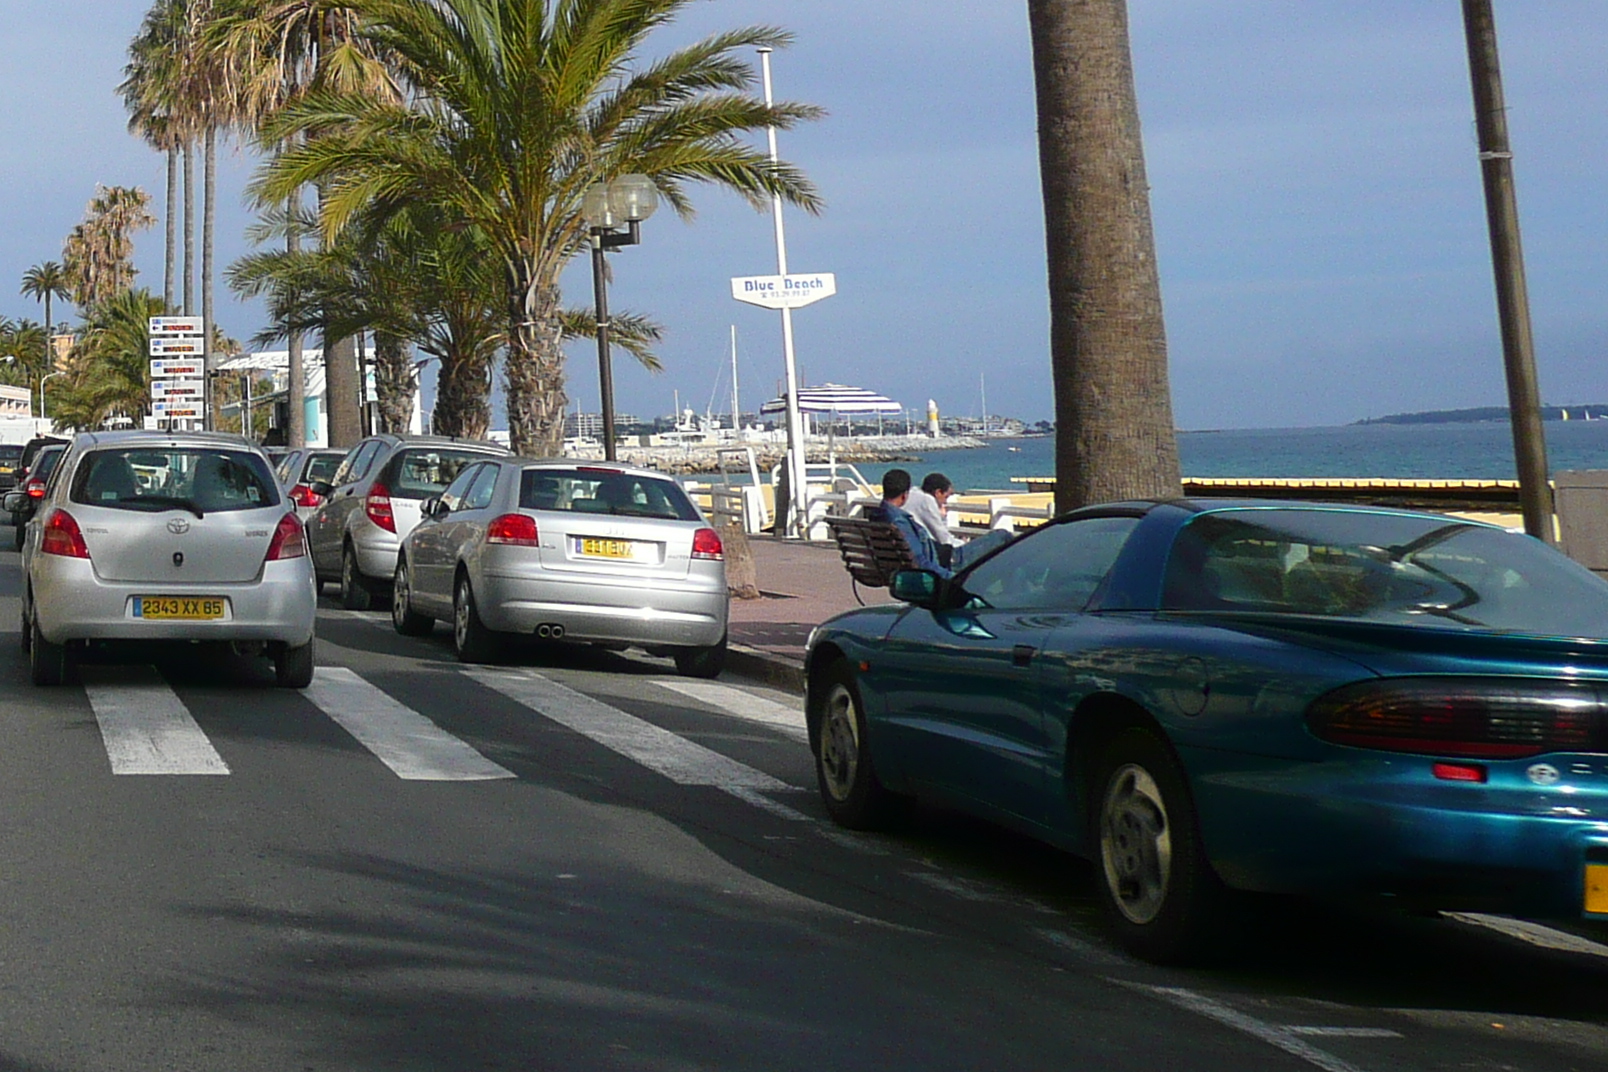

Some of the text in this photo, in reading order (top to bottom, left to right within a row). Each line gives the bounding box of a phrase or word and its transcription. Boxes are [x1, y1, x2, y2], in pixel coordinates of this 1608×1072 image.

[745, 277, 823, 291] Blue Beach
[142, 600, 222, 615] 2343 XX 85
